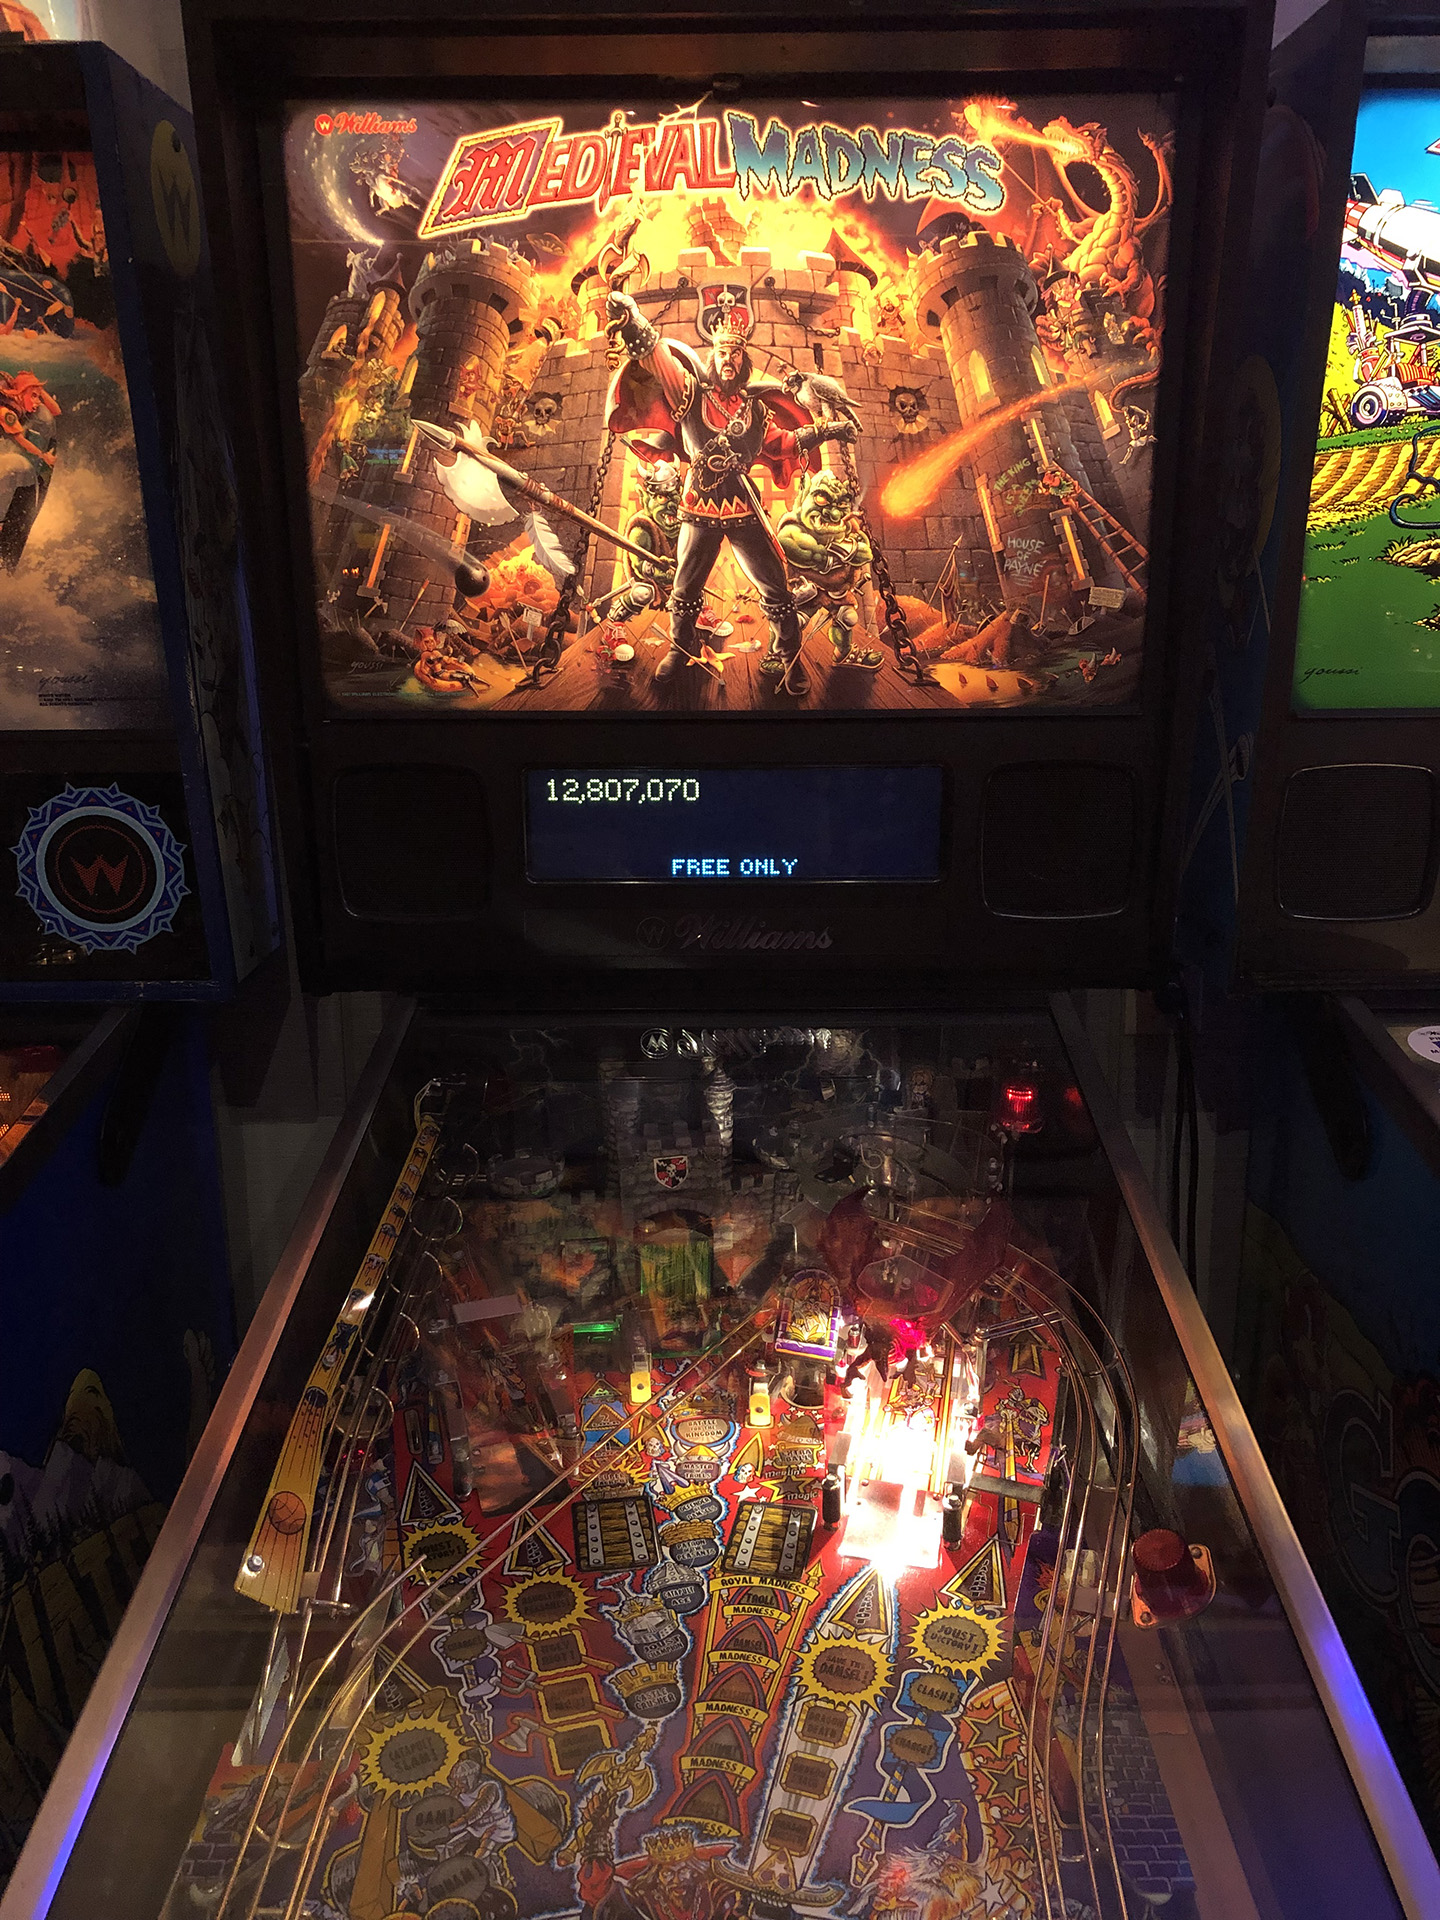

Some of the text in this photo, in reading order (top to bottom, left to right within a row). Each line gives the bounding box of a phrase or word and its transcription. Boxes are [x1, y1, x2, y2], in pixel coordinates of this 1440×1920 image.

[334, 112, 418, 135] Williams
[443, 112, 1004, 218] MEDIEVAL MADNESS
[1008, 536, 1045, 554] HOUSE
[1017, 551, 1031, 561] OF
[547, 778, 700, 804] 12,807,070
[671, 859, 798, 876] FREE ONLY
[675, 914, 833, 950] Williams
[688, 1419, 717, 1427] BATTLE
[686, 1430, 723, 1438] KINGDOM
[663, 1585, 695, 1599] CATAPULT
[721, 1577, 807, 1595] ROYAL MADNESS
[671, 1597, 692, 1607] ACE
[937, 1625, 977, 1643] JOUST
[634, 1692, 676, 1711] CRUSHER
[636, 1686, 668, 1702] CASTLE
